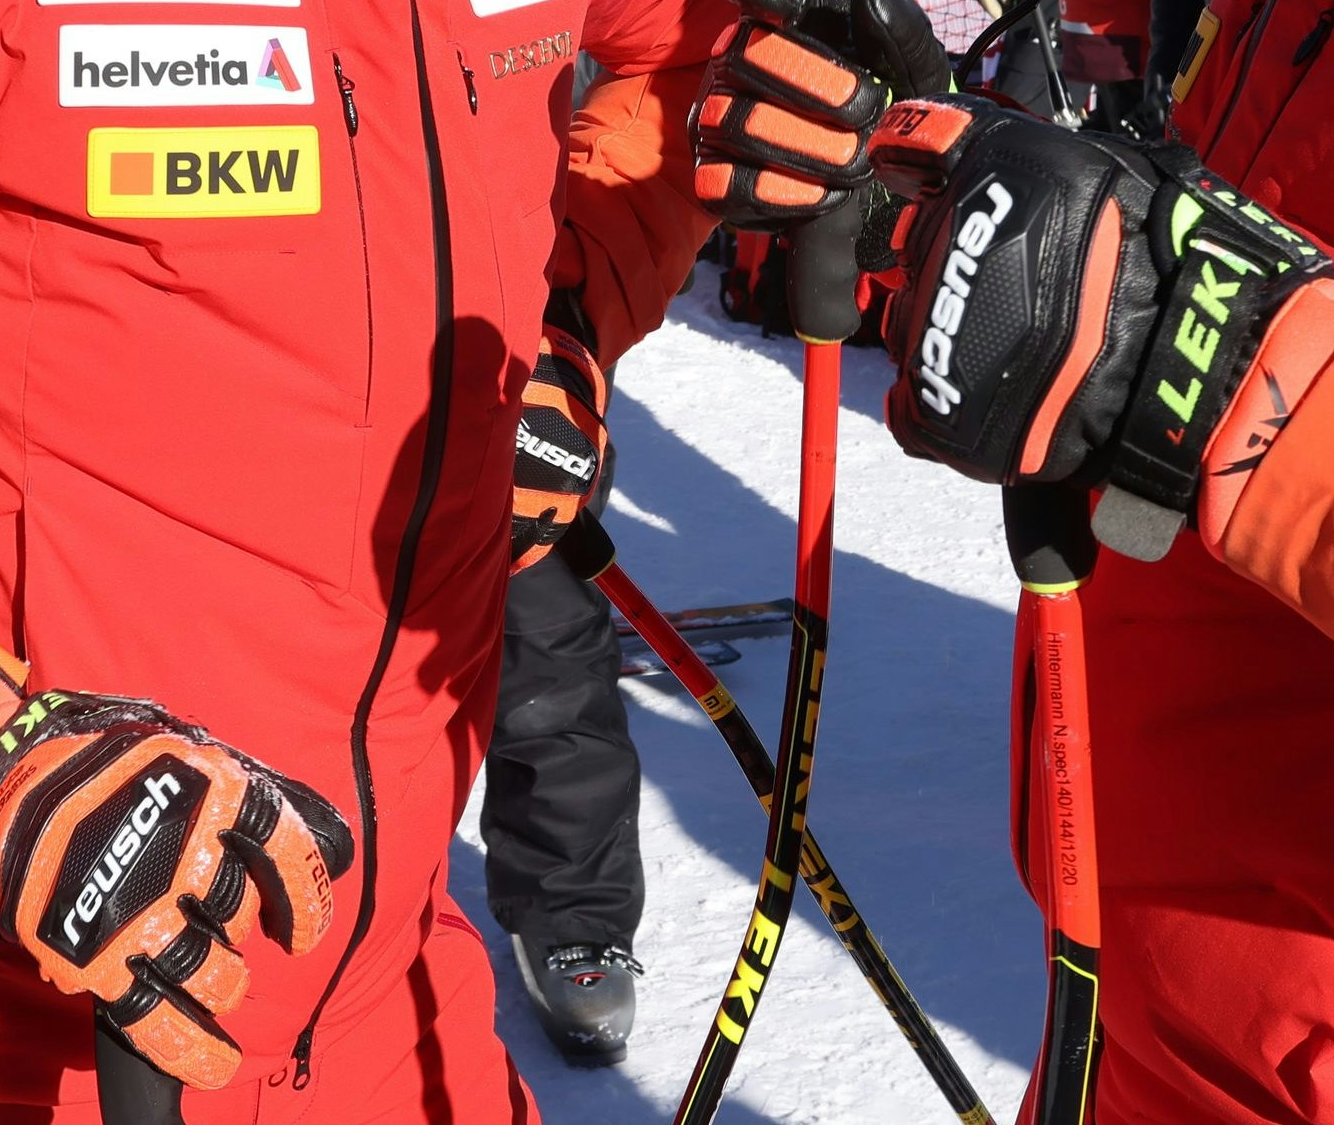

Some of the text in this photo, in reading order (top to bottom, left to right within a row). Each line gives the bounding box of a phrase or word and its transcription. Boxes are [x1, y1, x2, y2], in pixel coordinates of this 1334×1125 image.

[73, 49, 248, 88] helvetia
[166, 149, 300, 196] BKW
[922, 181, 1014, 415] reusch
[1047, 632, 1065, 720] Hintermann
[63, 772, 181, 947] reusch
[717, 857, 793, 1045] LEKI
